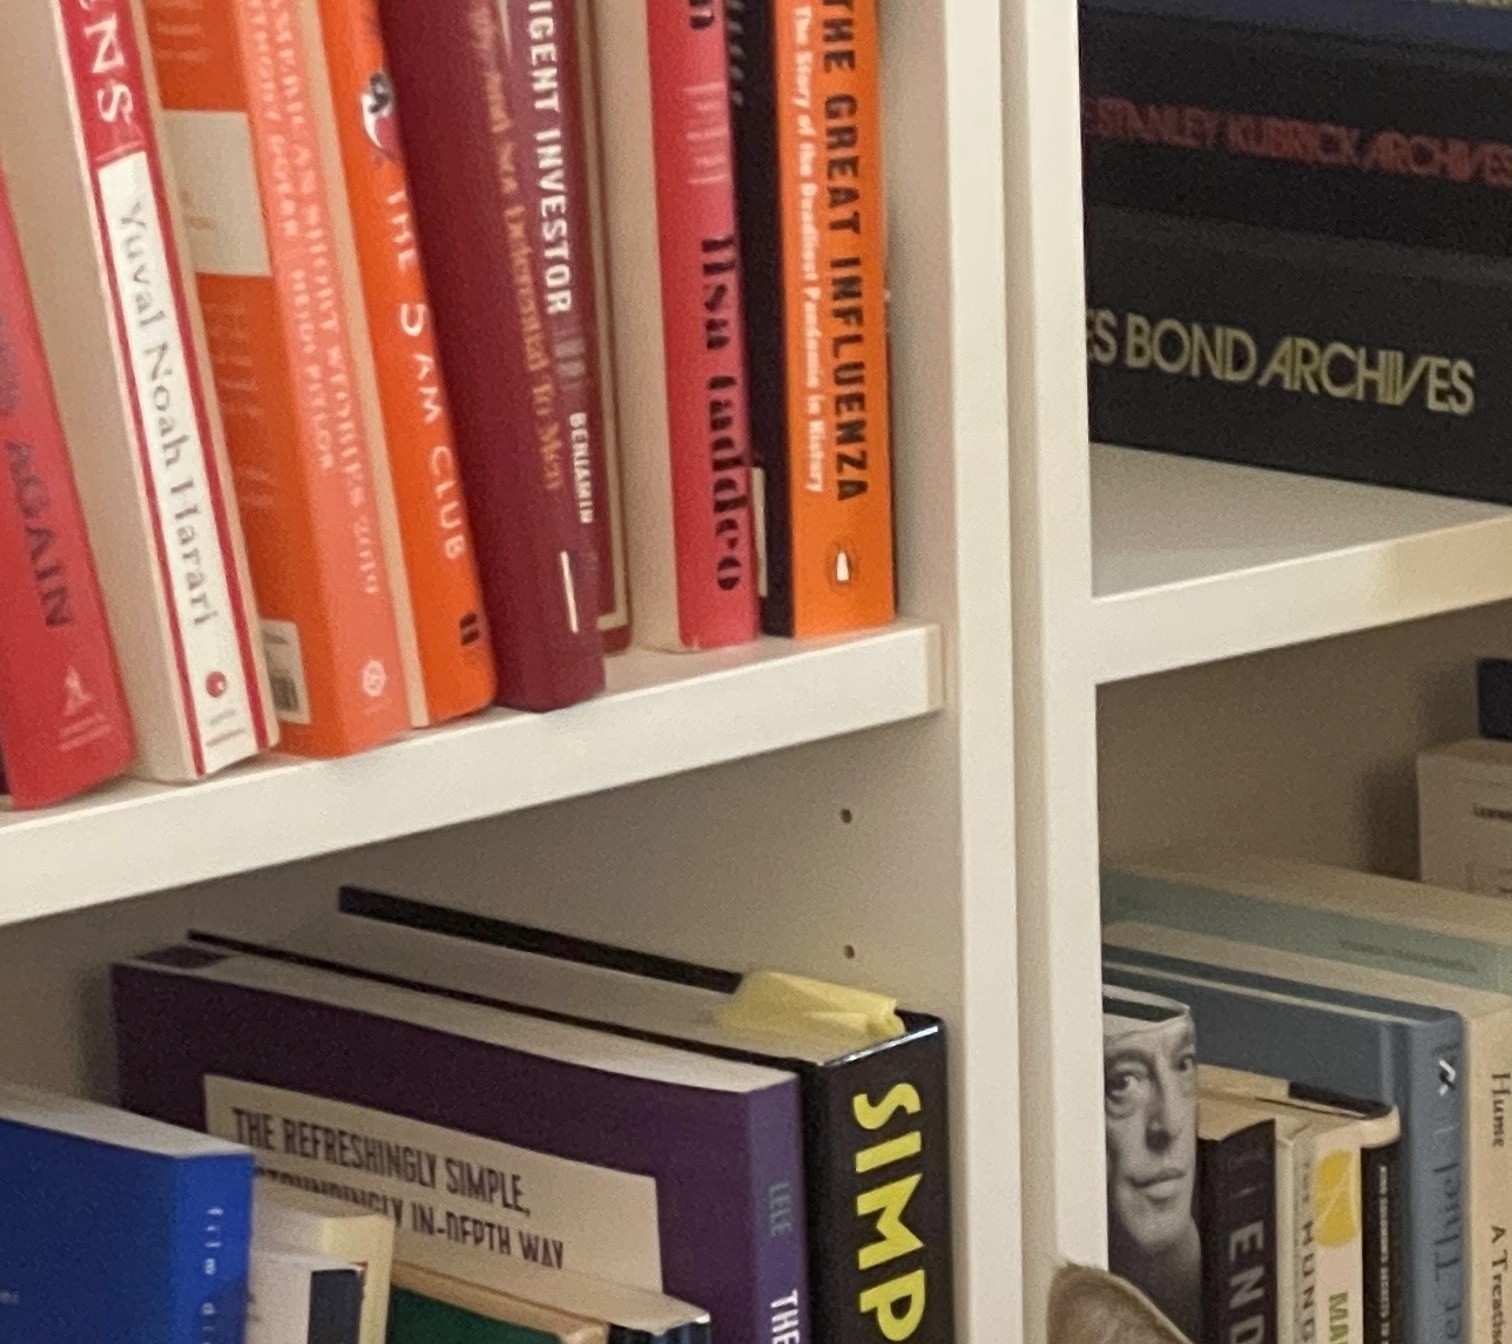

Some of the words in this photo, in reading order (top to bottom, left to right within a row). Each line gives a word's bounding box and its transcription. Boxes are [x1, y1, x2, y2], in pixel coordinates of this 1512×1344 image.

[75, 0, 137, 129] NS
[527, 0, 561, 117] IGENT
[789, 52, 815, 107] Story
[819, 0, 855, 73] THE
[822, 93, 861, 235] GREAT
[1227, 112, 1360, 170] KUBRICK
[386, 190, 417, 272] THE
[536, 128, 574, 317] INVESTOR
[400, 302, 430, 338] 5
[801, 286, 827, 387] Pandemic
[1126, 314, 1257, 383] BOND
[1258, 337, 1476, 415] ARCHIVES
[117, 202, 165, 328] Yuval
[142, 343, 192, 467] Noah
[167, 481, 218, 626] Harari
[412, 353, 443, 422] AM
[827, 256, 871, 501] INFLUENZA
[568, 411, 595, 525] BENJAMIN
[802, 419, 831, 492] History
[3, 436, 70, 630] AGAIN
[429, 447, 467, 560] CLUB
[231, 1107, 277, 1153] THE
[283, 1117, 438, 1187] REFRESHINGLY
[1489, 1071, 1512, 1148] Hume
[202, 1207, 225, 1277] film
[519, 1229, 565, 1270] WAY
[1427, 1160, 1465, 1282] Thiel
[1488, 1224, 1508, 1244] A
